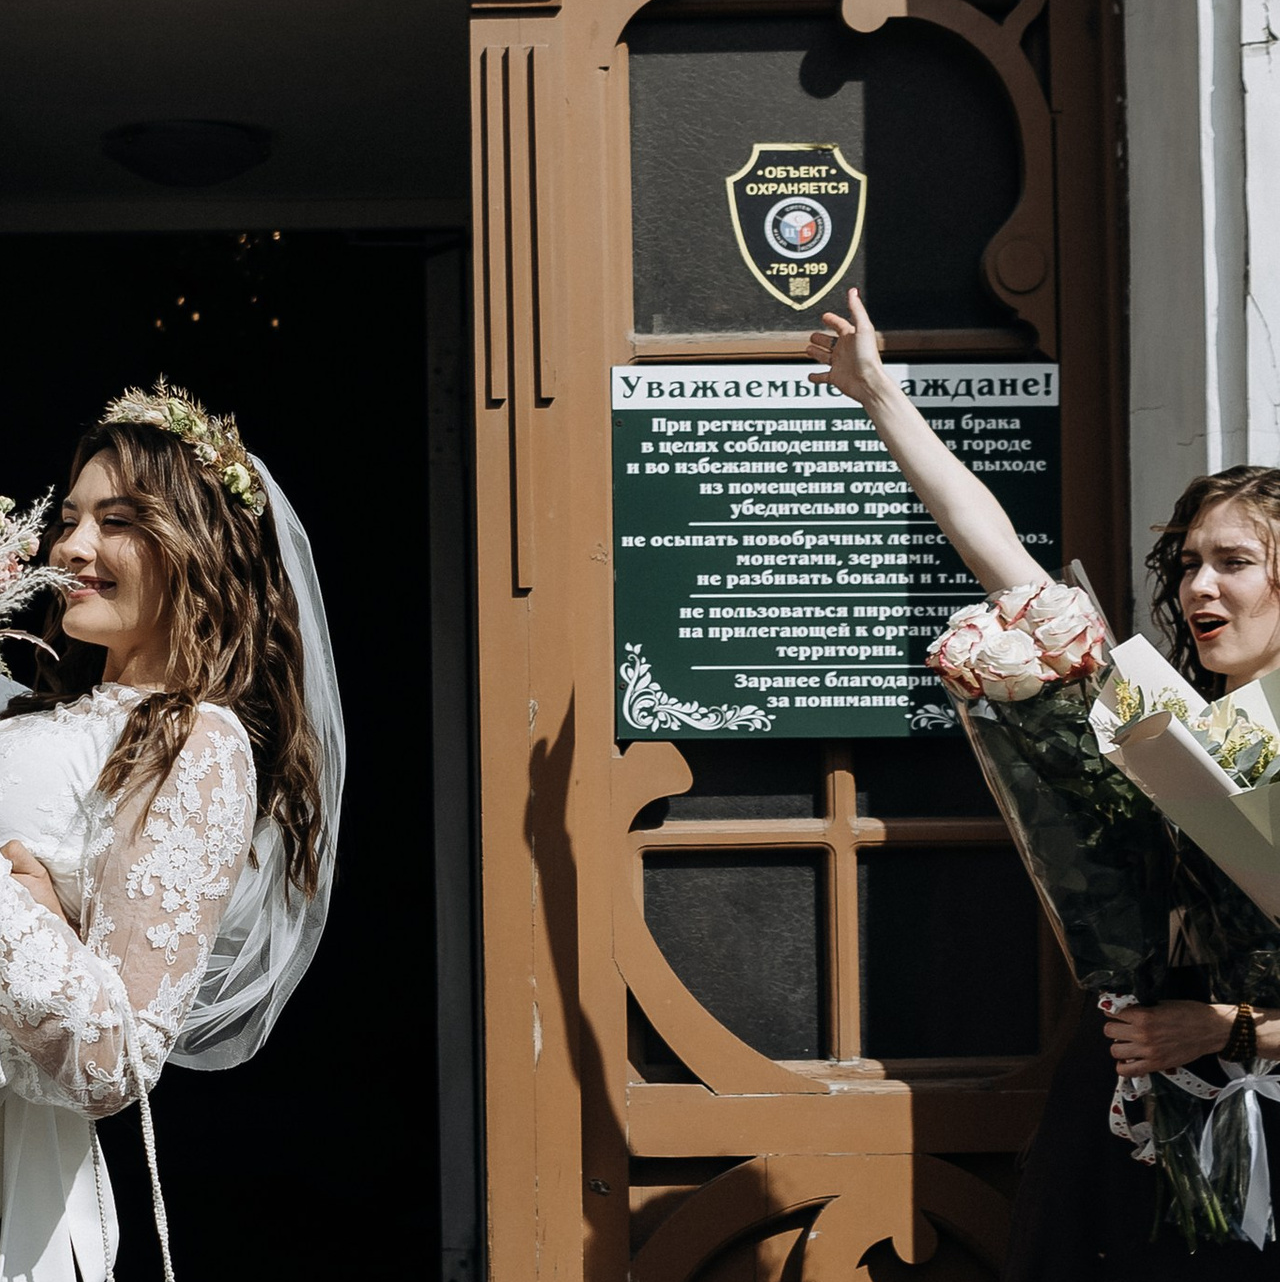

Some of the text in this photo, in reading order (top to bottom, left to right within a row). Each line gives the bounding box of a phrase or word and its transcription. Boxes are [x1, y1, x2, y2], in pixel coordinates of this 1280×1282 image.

[764, 166, 829, 179] ОБЪЕКТ
[745, 182, 849, 195] ОХРАНЯЕТСЯ
[901, 373, 1052, 401] аждане!
[651, 418, 692, 435] При
[697, 418, 826, 435] регистрации
[961, 414, 1020, 434] брака
[641, 442, 654, 453] в
[659, 441, 719, 456] целях
[723, 437, 849, 455] соблюдения
[946, 440, 957, 451] в
[962, 439, 1032, 454] городе
[626, 457, 1047, 476] и во избежание травматиз выходе
[699, 483, 724, 495] из
[728, 482, 845, 497] помещения
[730, 498, 930, 519] убедительно проси
[621, 535, 646, 548] не
[650, 535, 739, 548] осыпать
[742, 530, 883, 549] новобрачных
[886, 533, 952, 546] лепес
[736, 553, 941, 568] монетами, зернами,
[697, 574, 721, 586] не
[726, 569, 833, 589] разбивать
[836, 569, 914, 585] бокалы
[921, 573, 932, 584] и
[679, 605, 962, 621] не пользоваться пиротехни
[678, 623, 943, 641] на прилегающей к органу
[775, 645, 904, 661] территории.
[734, 674, 821, 691] Заранее
[766, 695, 915, 708] за понимание.
